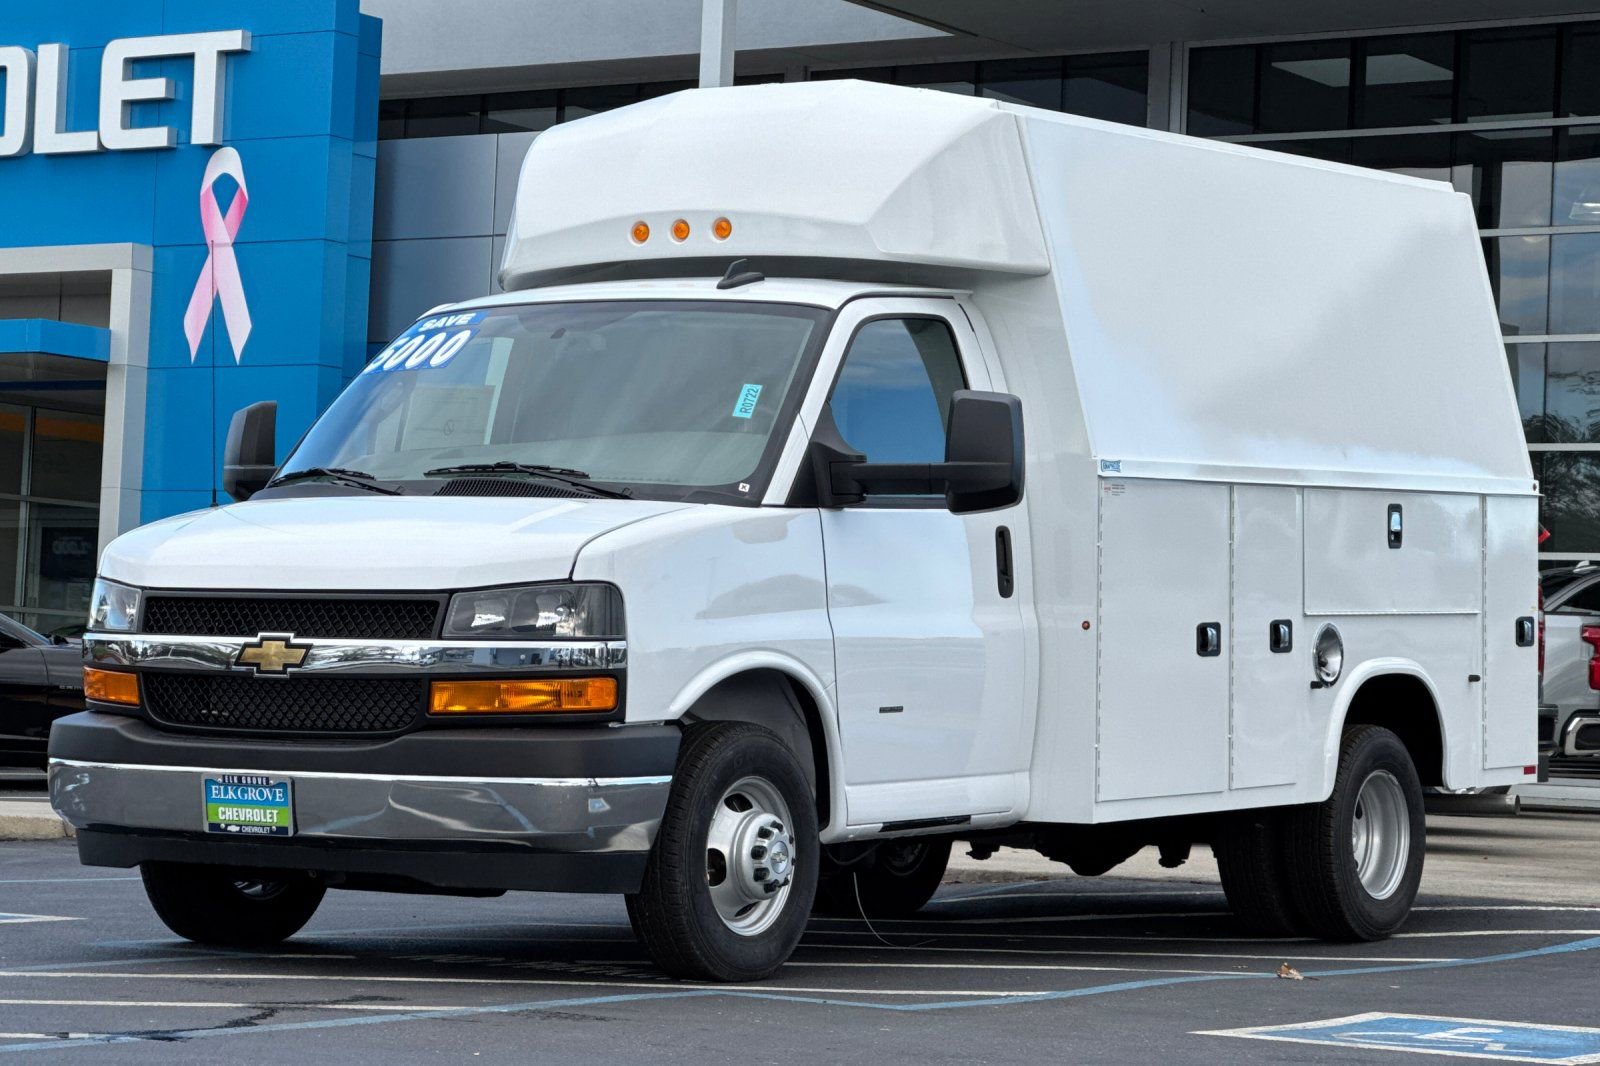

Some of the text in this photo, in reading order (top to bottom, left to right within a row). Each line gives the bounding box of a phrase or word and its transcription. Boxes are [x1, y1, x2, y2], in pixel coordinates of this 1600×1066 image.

[418, 313, 477, 332] SAVE
[225, 775, 267, 785] ELK GROVE
[218, 807, 278, 823] CHEVROLET
[241, 825, 271, 834] CHEVROLET
